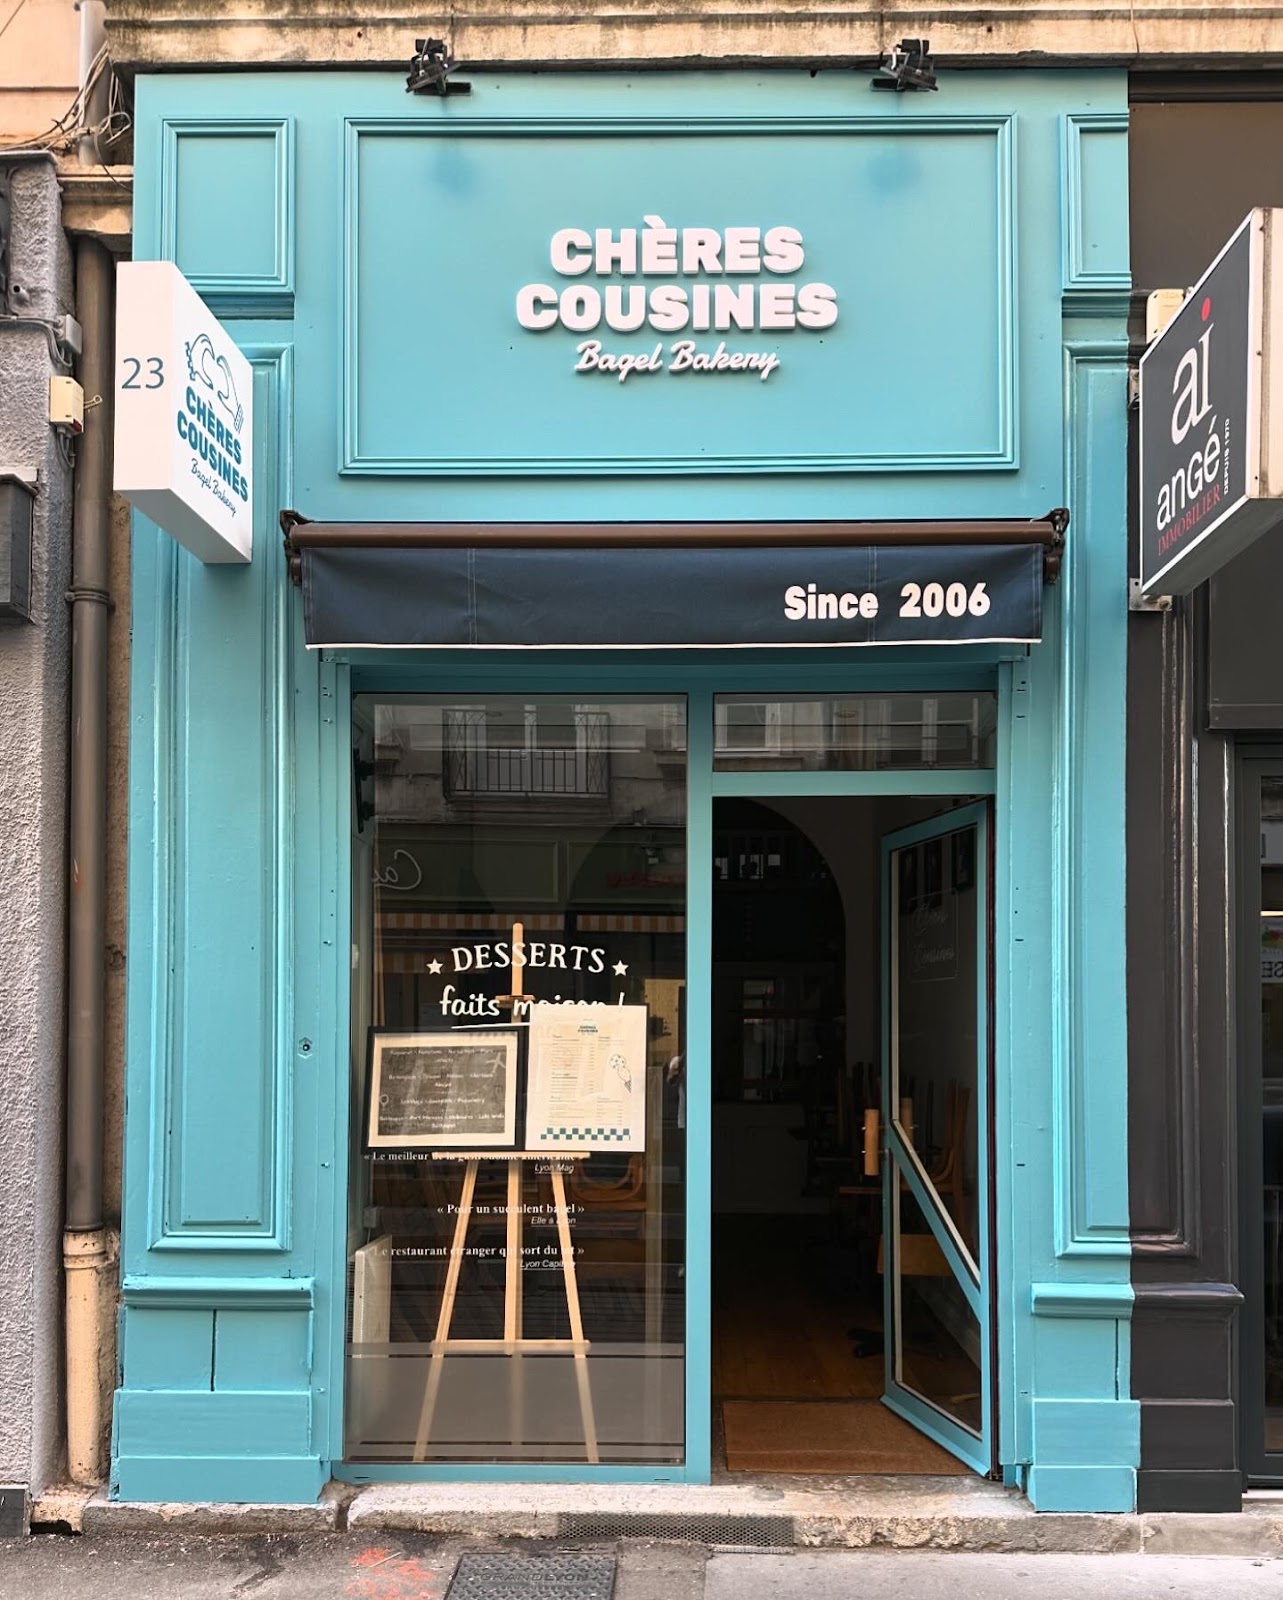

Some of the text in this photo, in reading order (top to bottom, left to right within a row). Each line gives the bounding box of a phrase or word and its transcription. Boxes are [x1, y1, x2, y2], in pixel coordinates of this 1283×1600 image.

[550, 215, 805, 275] CHÈRES
[516, 283, 839, 332] COUSINES
[121, 357, 165, 389] 23
[574, 340, 780, 383] Bagel Bakery
[186, 386, 241, 465] CHÈRES
[176, 410, 248, 502] COUSINES
[191, 457, 237, 518] Bagel Bakery
[1157, 482, 1222, 557] IMMOBILIER
[784, 582, 991, 620] Since 2006
[451, 942, 605, 974] DESSERTS
[439, 985, 500, 1016] faits
[373, 1151, 386, 1160] Le
[388, 1151, 429, 1160] meilleur
[534, 1163, 575, 1174] Lyon Mag
[476, 1206, 490, 1214] un
[493, 1203, 543, 1214] suculent
[546, 1203, 575, 1216] bael
[530, 1216, 546, 1225] Elle
[556, 1216, 576, 1226] on
[391, 1246, 447, 1256] restaurant
[544, 1244, 558, 1255] du
[520, 1259, 576, 1270] Lyon Capi
